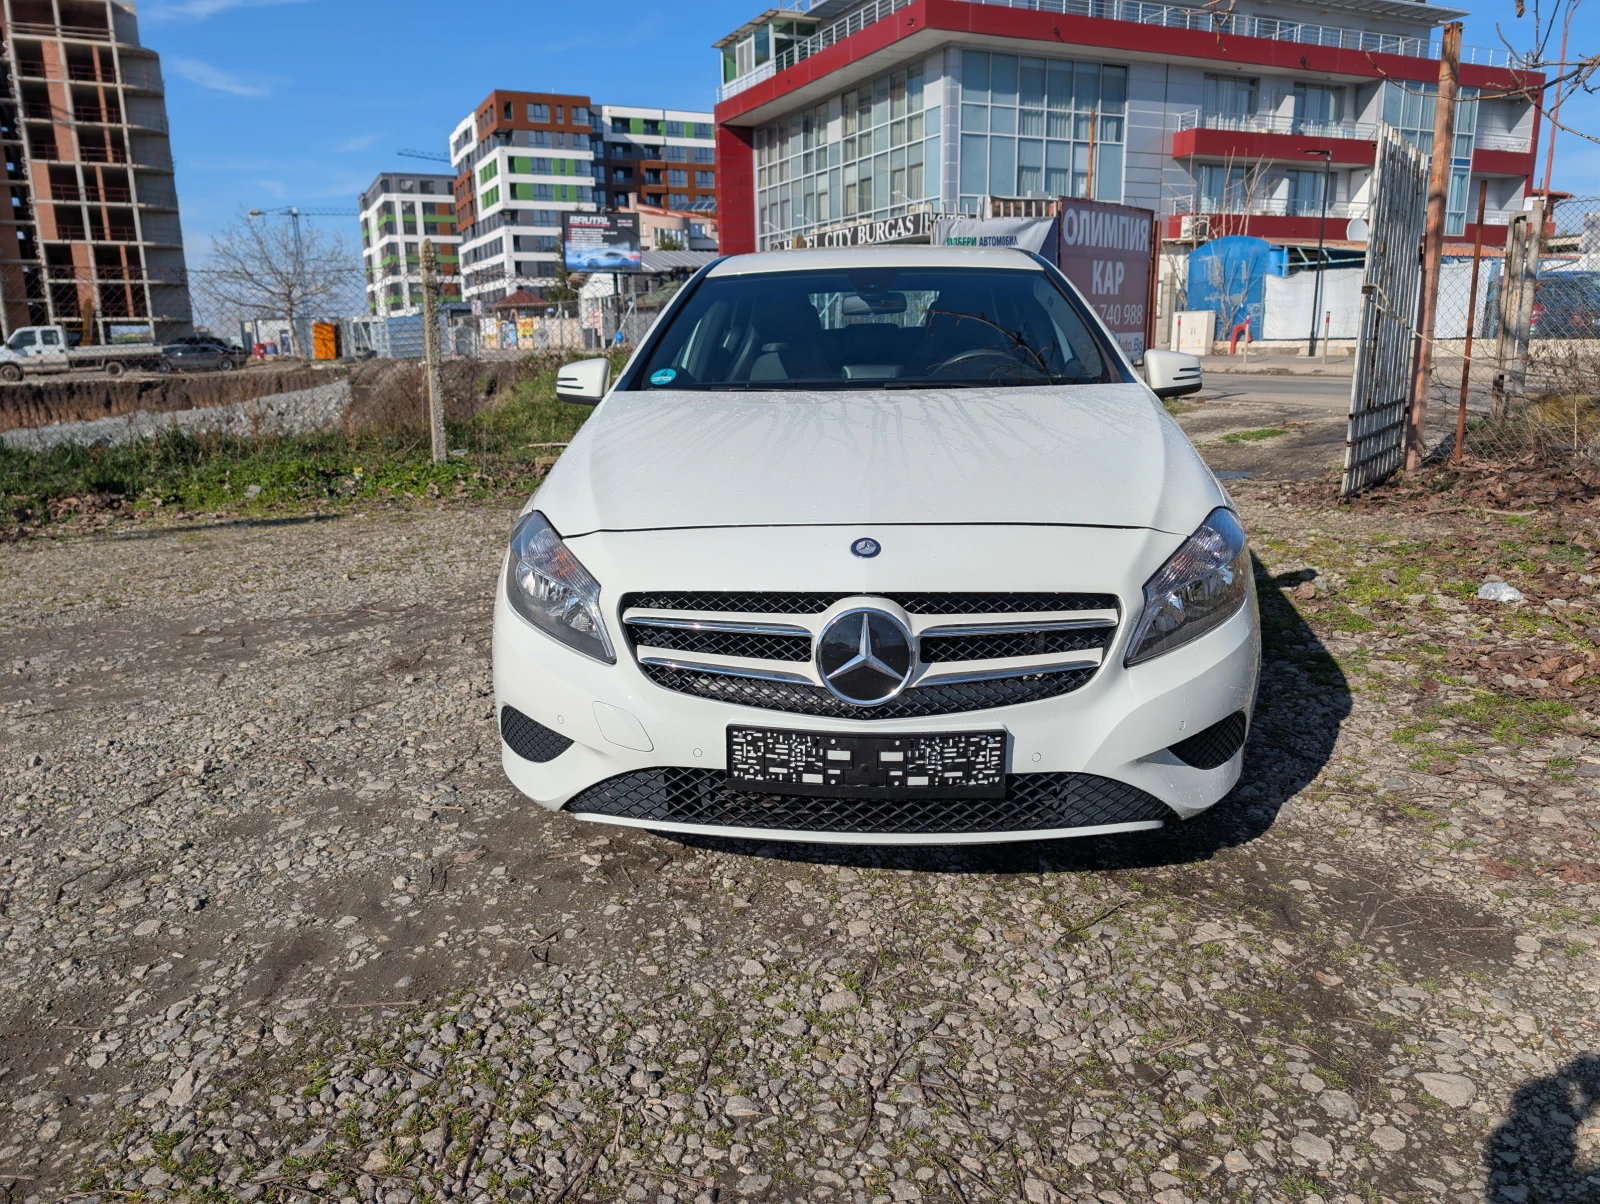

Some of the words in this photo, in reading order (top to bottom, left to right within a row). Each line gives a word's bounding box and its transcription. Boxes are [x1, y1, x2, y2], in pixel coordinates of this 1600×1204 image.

[569, 215, 610, 225] BRUTAL
[824, 227, 854, 247] CITY
[857, 215, 914, 245] BURGAS
[1063, 208, 1149, 252] ОЛИМПИЯ
[979, 235, 1019, 247] АВТОМОБИЛ
[1091, 260, 1125, 295] КАР
[1099, 304, 1121, 325] 740
[1123, 304, 1143, 325] 988
